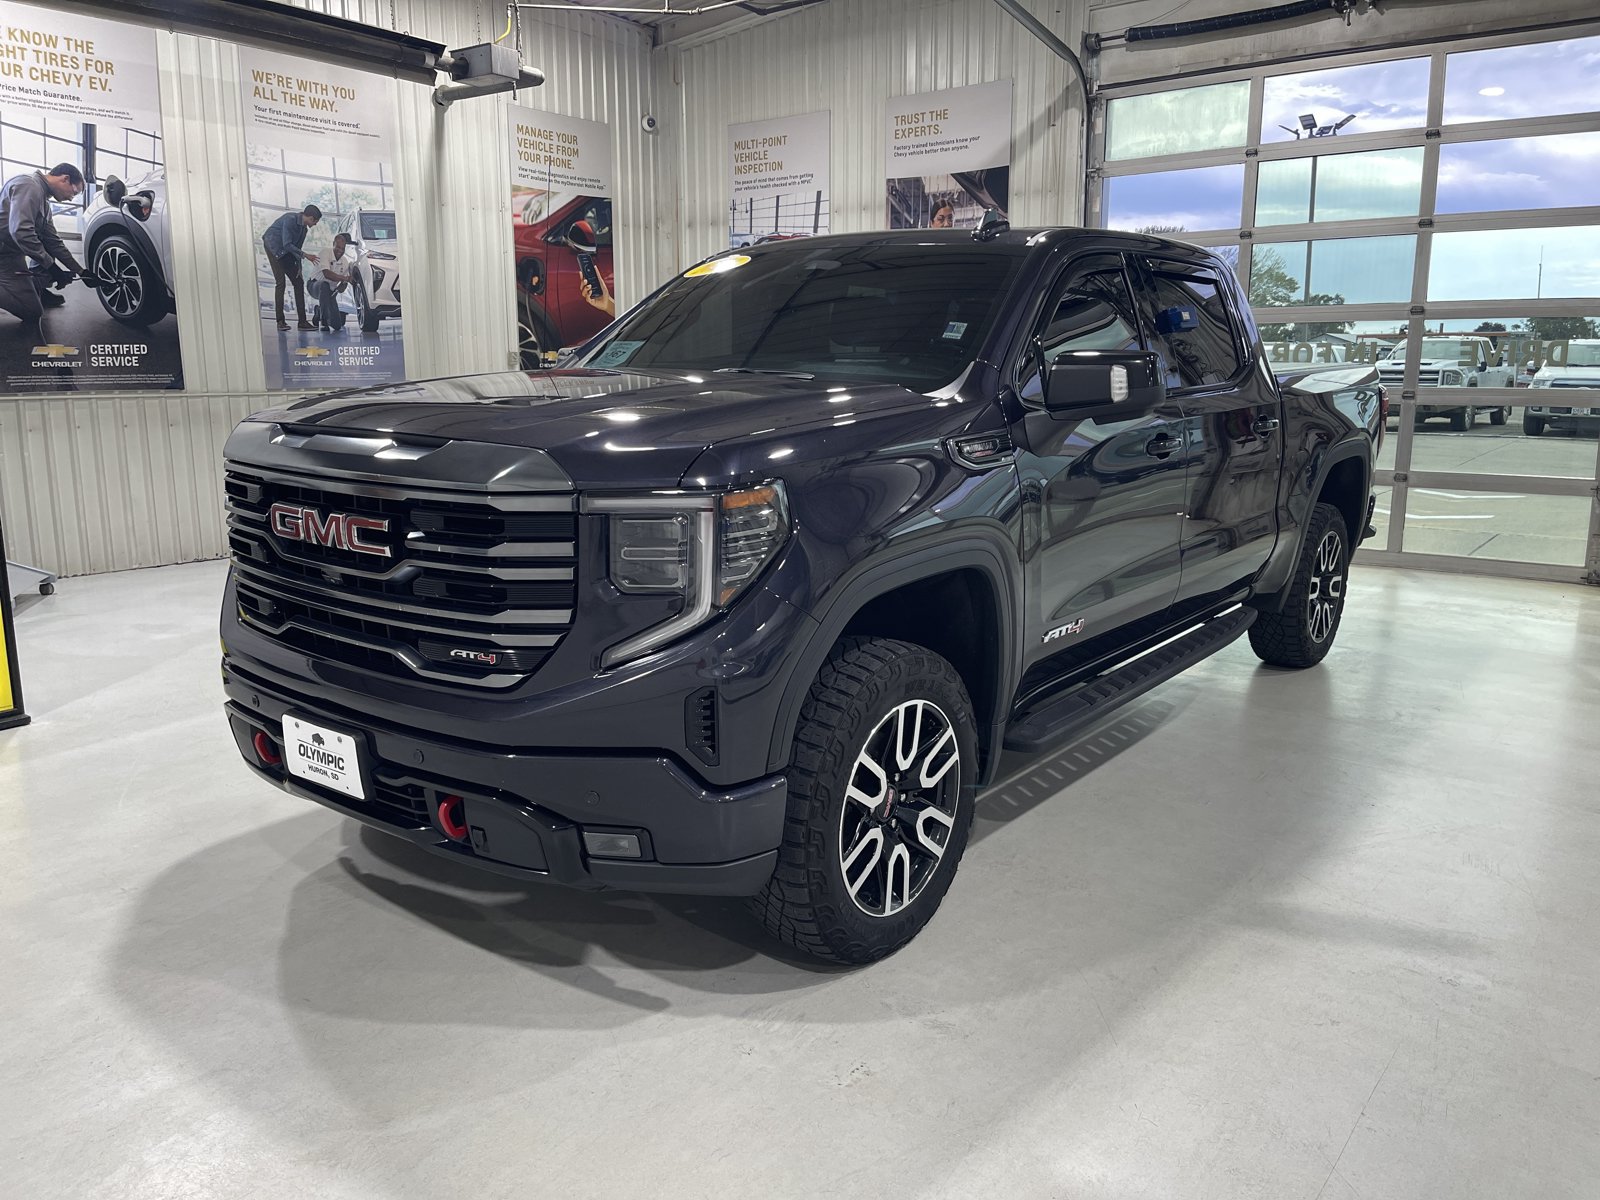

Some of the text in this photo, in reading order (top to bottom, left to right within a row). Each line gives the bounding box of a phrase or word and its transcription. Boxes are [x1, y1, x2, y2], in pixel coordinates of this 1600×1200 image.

[7, 26, 59, 49] KNOW
[63, 36, 95, 55] THE
[32, 49, 80, 70] TIRES
[85, 59, 115, 75] FOR
[28, 66, 84, 88] CHEVY
[88, 76, 113, 93] EV.
[252, 69, 356, 101] WE'RE WITH YOU
[0, 83, 16, 93] rice
[18, 86, 41, 96] Match
[253, 86, 338, 113] ALL THE WAY.
[254, 104, 267, 113] Your
[268, 107, 282, 116] first
[283, 111, 318, 123] maintenance
[319, 117, 331, 125] visit
[894, 108, 949, 126] TRUST THE
[516, 123, 578, 145] MANAGE YOUR
[894, 123, 943, 140] EXPERTS.
[517, 136, 579, 158] VEHICLE FROM
[734, 135, 788, 151] MULTI-POINT
[929, 139, 955, 147] technicians
[517, 149, 575, 170] YOUR PHONE.
[734, 150, 768, 163] VEHICLE
[734, 160, 783, 175] INSPECTION
[90, 344, 148, 355] CERTIFIED
[337, 346, 380, 356] CERTIFIED
[91, 356, 140, 367] SERVICE
[338, 356, 374, 366] SERVICE
[270, 502, 393, 558] GMC
[1041, 618, 1085, 644] AT4
[450, 648, 497, 665] AT4
[298, 743, 345, 771] OLYMPIC
[331, 772, 339, 781] SD
